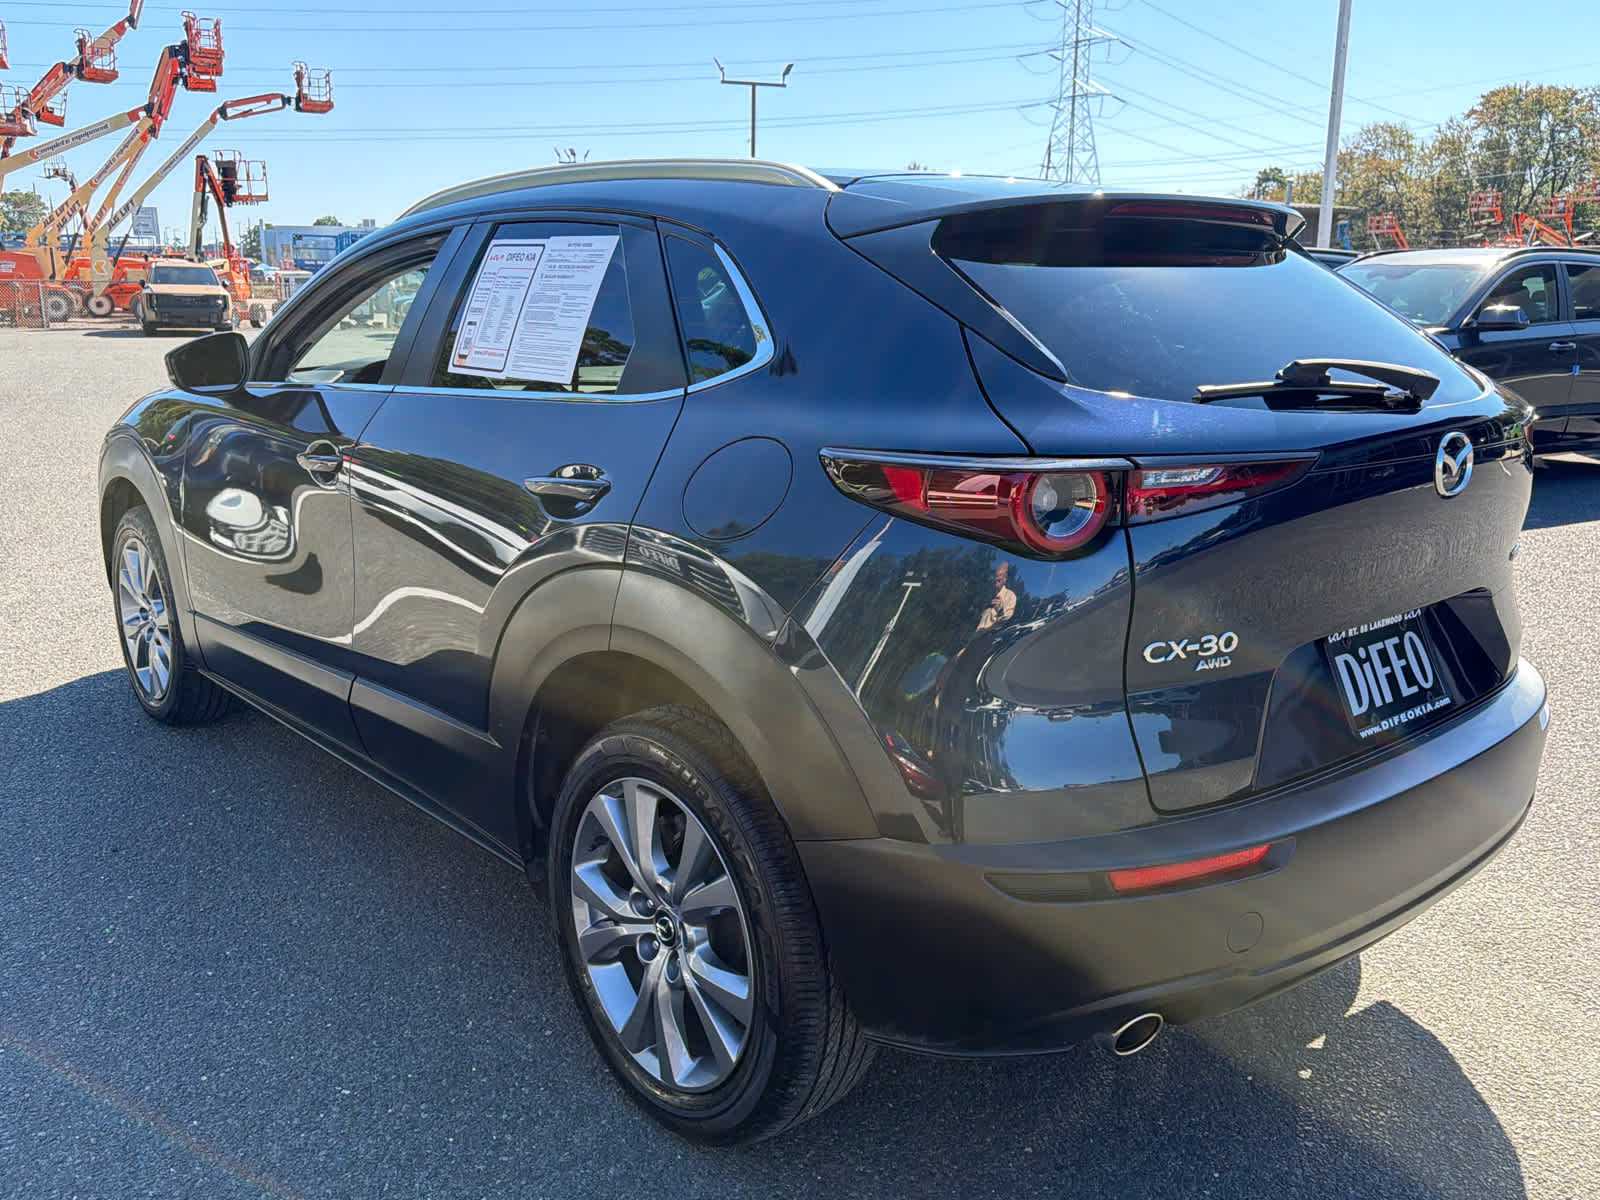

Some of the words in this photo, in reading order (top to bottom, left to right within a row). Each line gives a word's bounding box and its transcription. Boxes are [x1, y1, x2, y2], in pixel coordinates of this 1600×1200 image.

[107, 215, 120, 231] JLG
[119, 198, 136, 217] LIFT
[1369, 614, 1403, 630] LAKEWOOD
[1143, 631, 1239, 664] CX-30
[1194, 655, 1232, 671] AWD
[1360, 697, 1452, 739] www.DIFEOKIA.com
